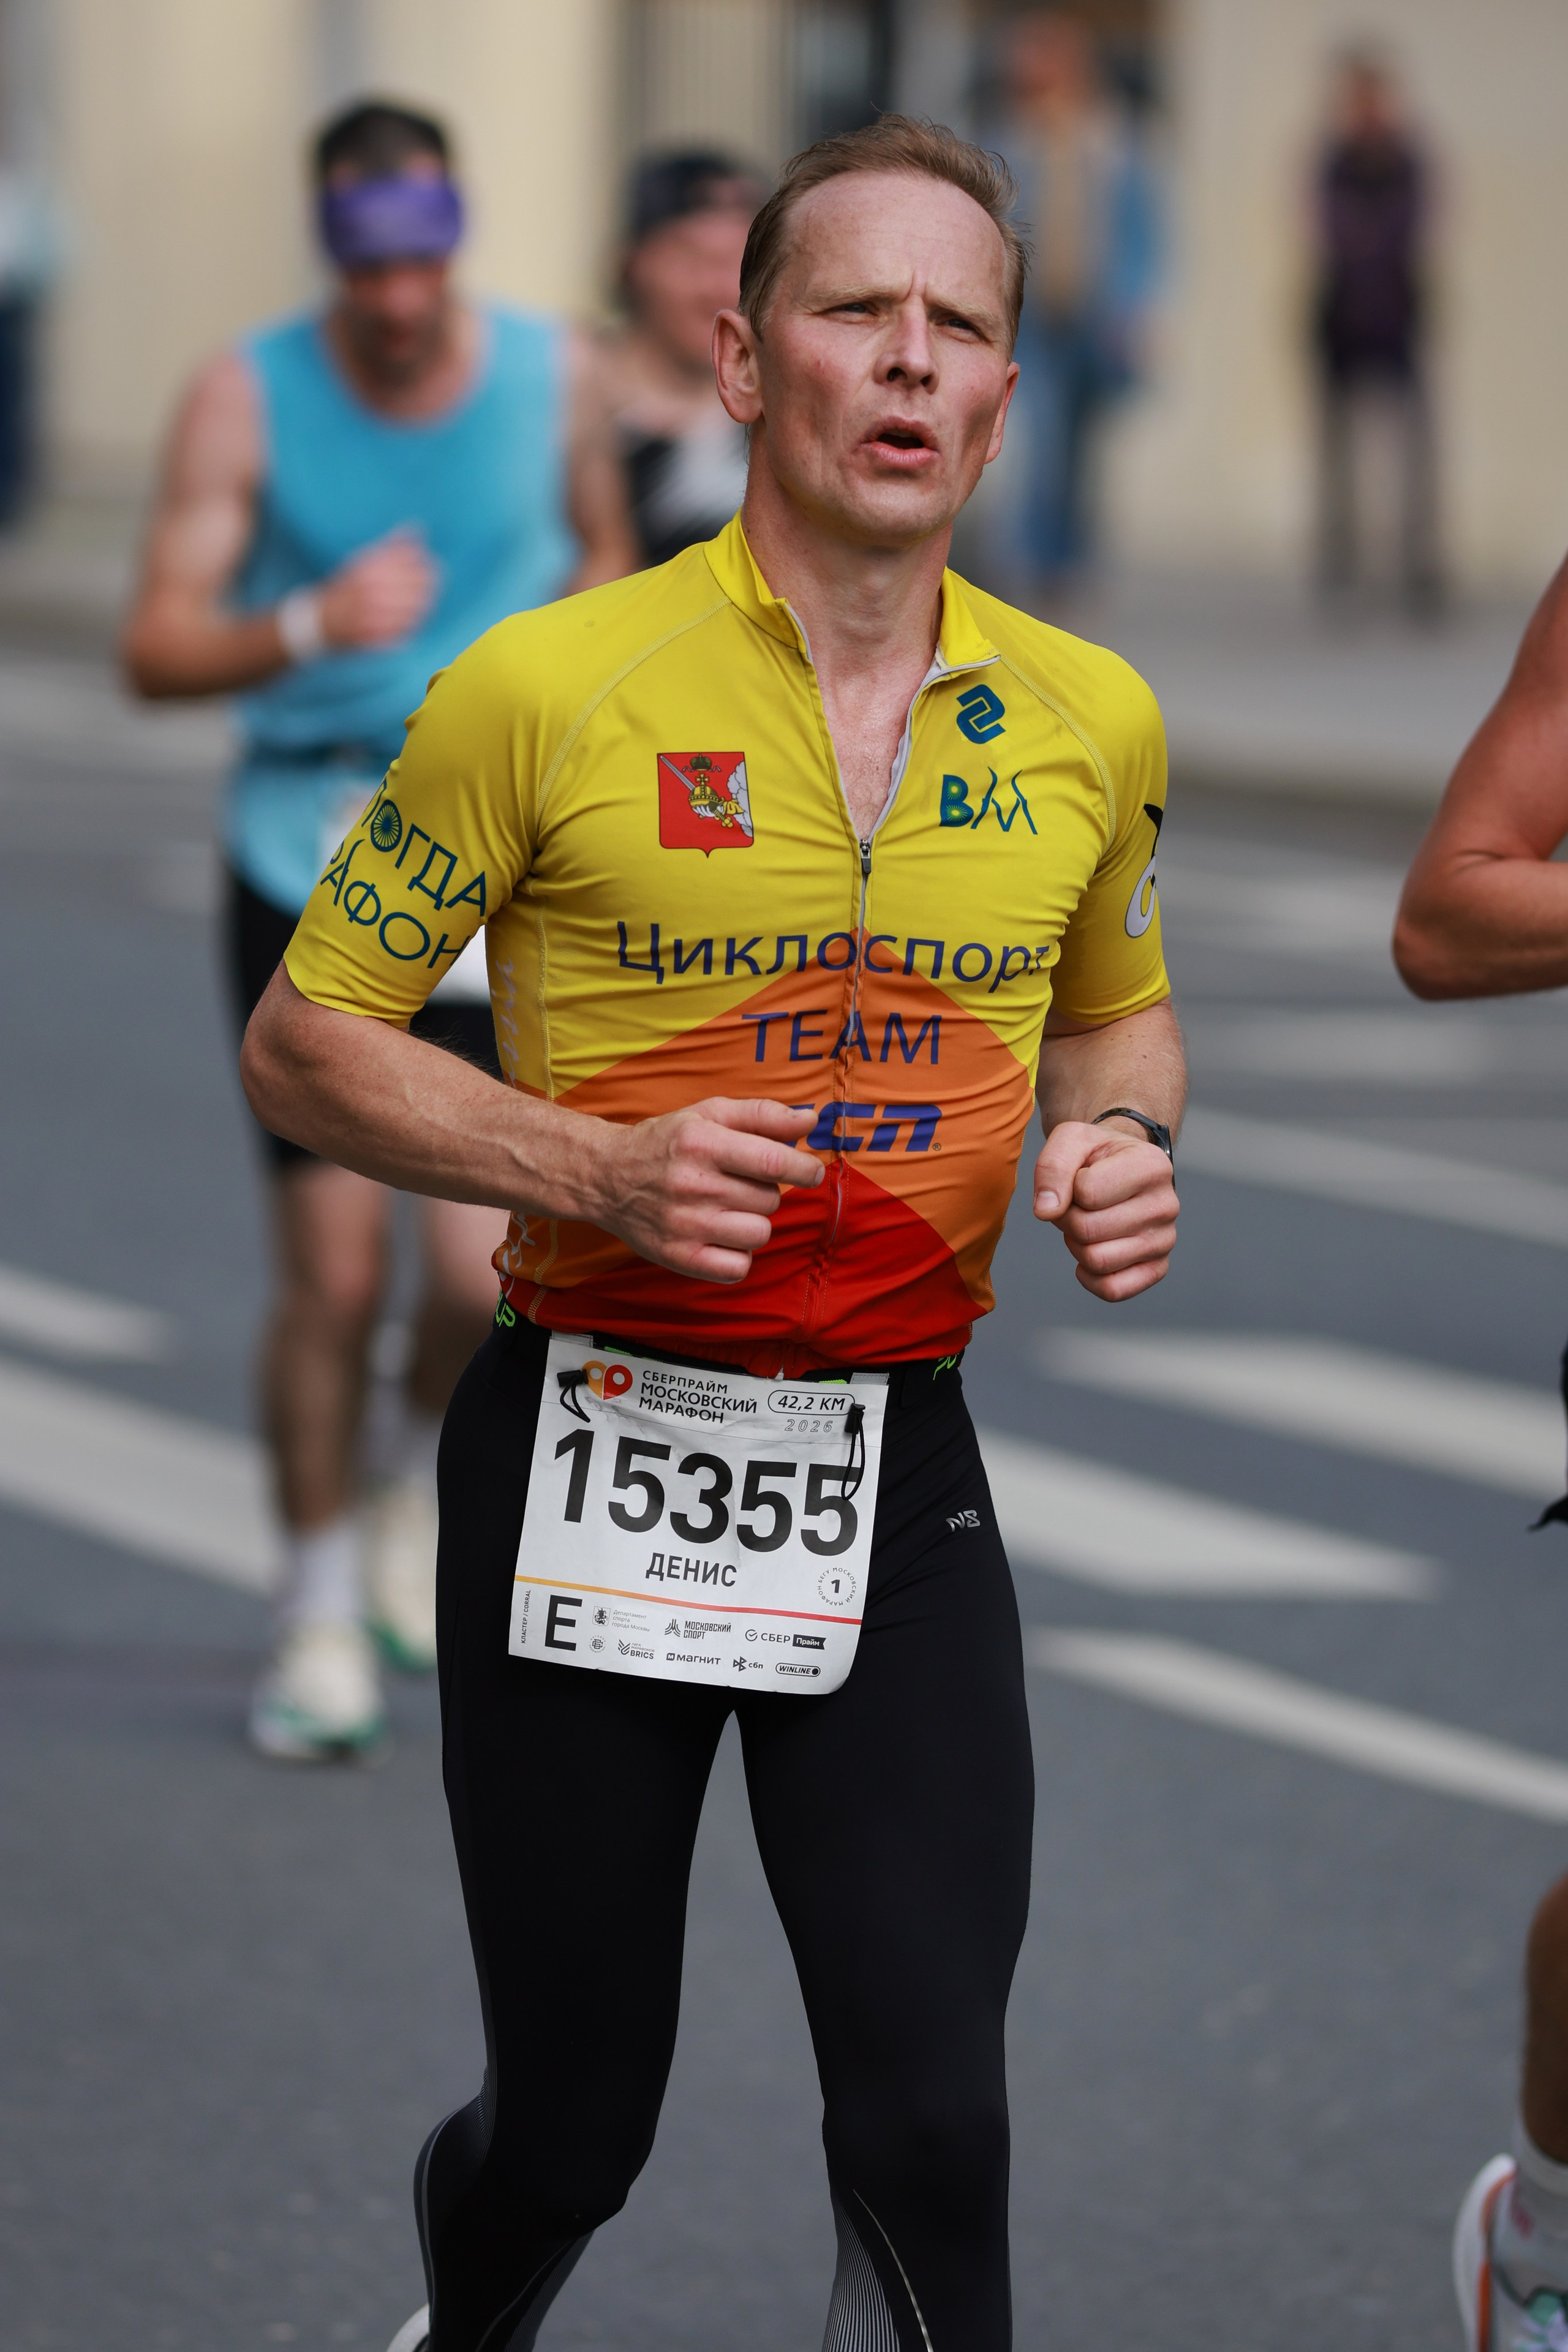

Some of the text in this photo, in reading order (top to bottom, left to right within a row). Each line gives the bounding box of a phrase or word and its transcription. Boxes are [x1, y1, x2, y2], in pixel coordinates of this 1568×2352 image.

[617, 921, 1050, 993] Циклоспорт
[742, 1009, 942, 1065] TEAM
[786, 1101, 943, 1152] СП
[643, 1370, 728, 1394] СБЕРПРАЙМ
[641, 1382, 758, 1414] МОСКОВСКИЙ
[778, 1395, 814, 1411] 42,2
[639, 1396, 724, 1424] МАРАФОН
[785, 1419, 833, 1433] 2026
[554, 1428, 862, 1556] 15355
[645, 1552, 738, 1588] ДЕНИС
[818, 1569, 829, 1583] БЕГУ
[831, 1579, 840, 1594] 1
[613, 1609, 647, 1619] Департамент
[684, 1620, 731, 1633] МОСКОВСКИЙ
[684, 1630, 706, 1640] СПОРТ
[761, 1632, 820, 1647] СБЕР Прайм
[630, 1649, 654, 1660] BRICS
[677, 1654, 721, 1665] магнит
[779, 1665, 811, 1674] WINLINE
